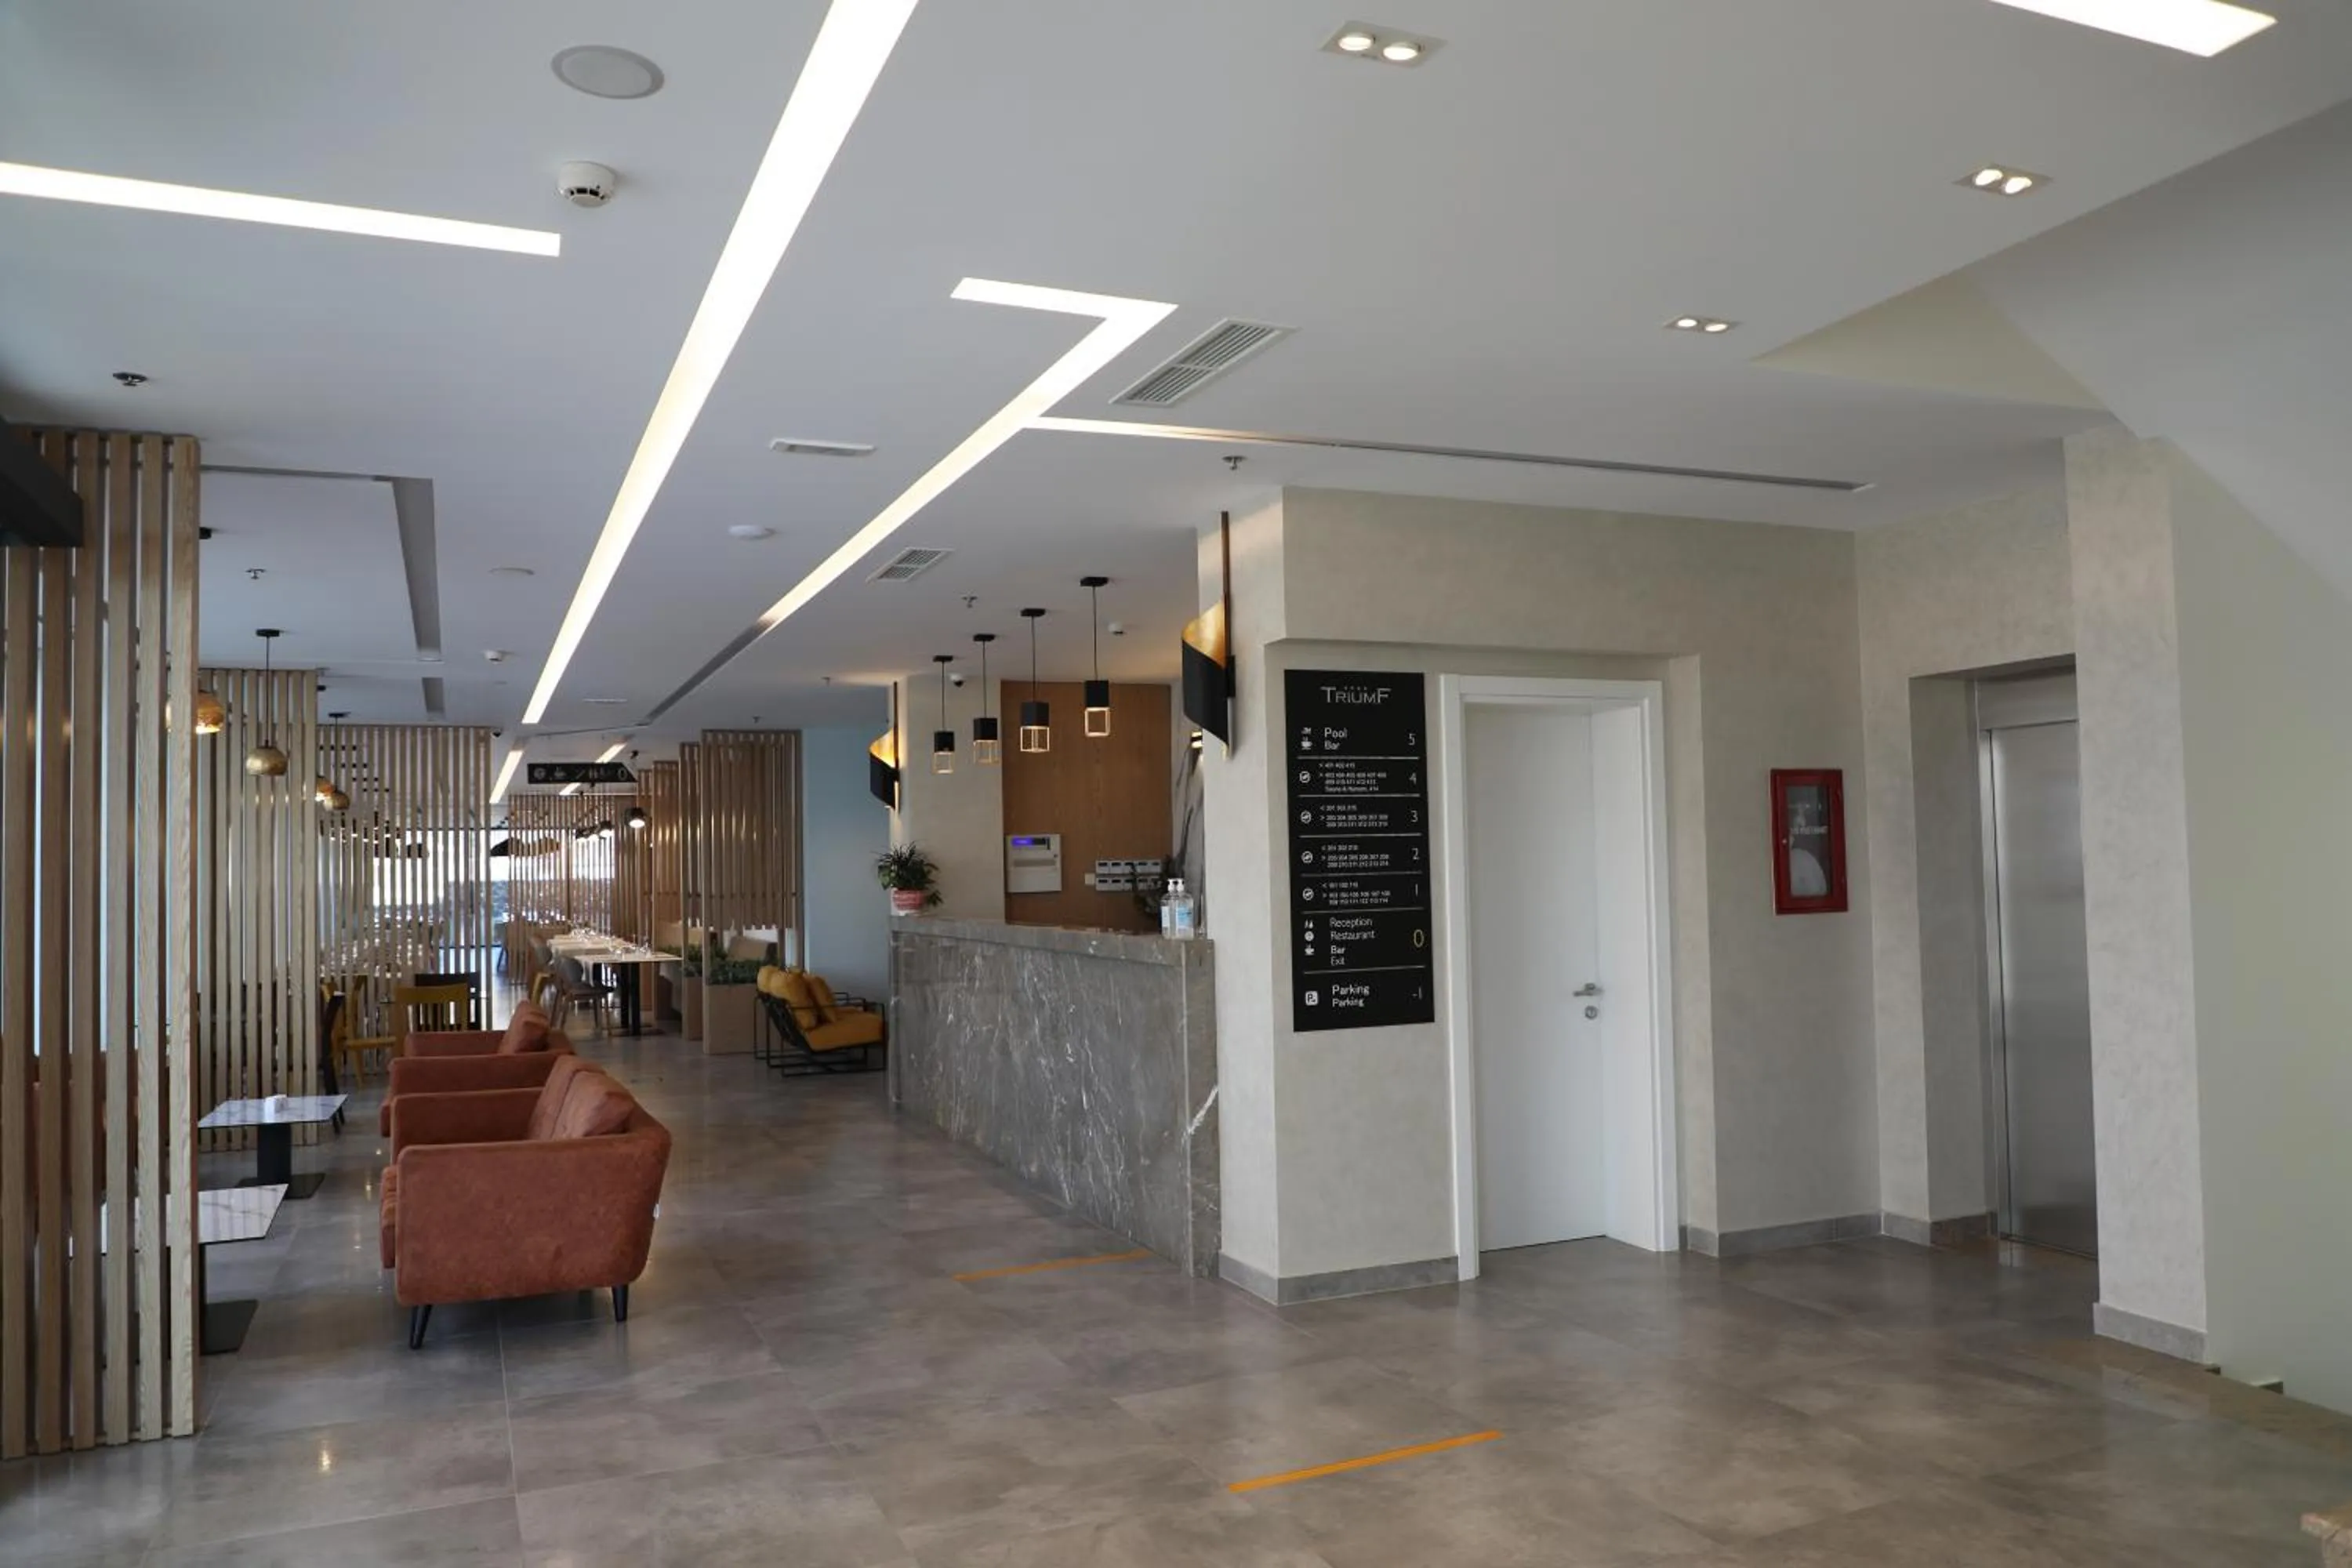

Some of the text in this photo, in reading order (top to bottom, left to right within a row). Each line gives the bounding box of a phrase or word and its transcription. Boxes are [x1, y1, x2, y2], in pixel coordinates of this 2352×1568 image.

[1323, 727, 1348, 738] Pool
[1324, 740, 1341, 750] Bar
[1409, 733, 1416, 746] 5
[1409, 772, 1417, 785] 4
[1410, 810, 1418, 822] 3
[1412, 848, 1420, 860] 2
[1330, 917, 1373, 928] Reception
[1330, 930, 1375, 941] Restaurant
[1414, 929, 1425, 948] 0
[1330, 945, 1346, 955] Bar
[1330, 956, 1345, 966] Exit
[1332, 985, 1370, 996] Parking
[1332, 998, 1365, 1007] Parking
